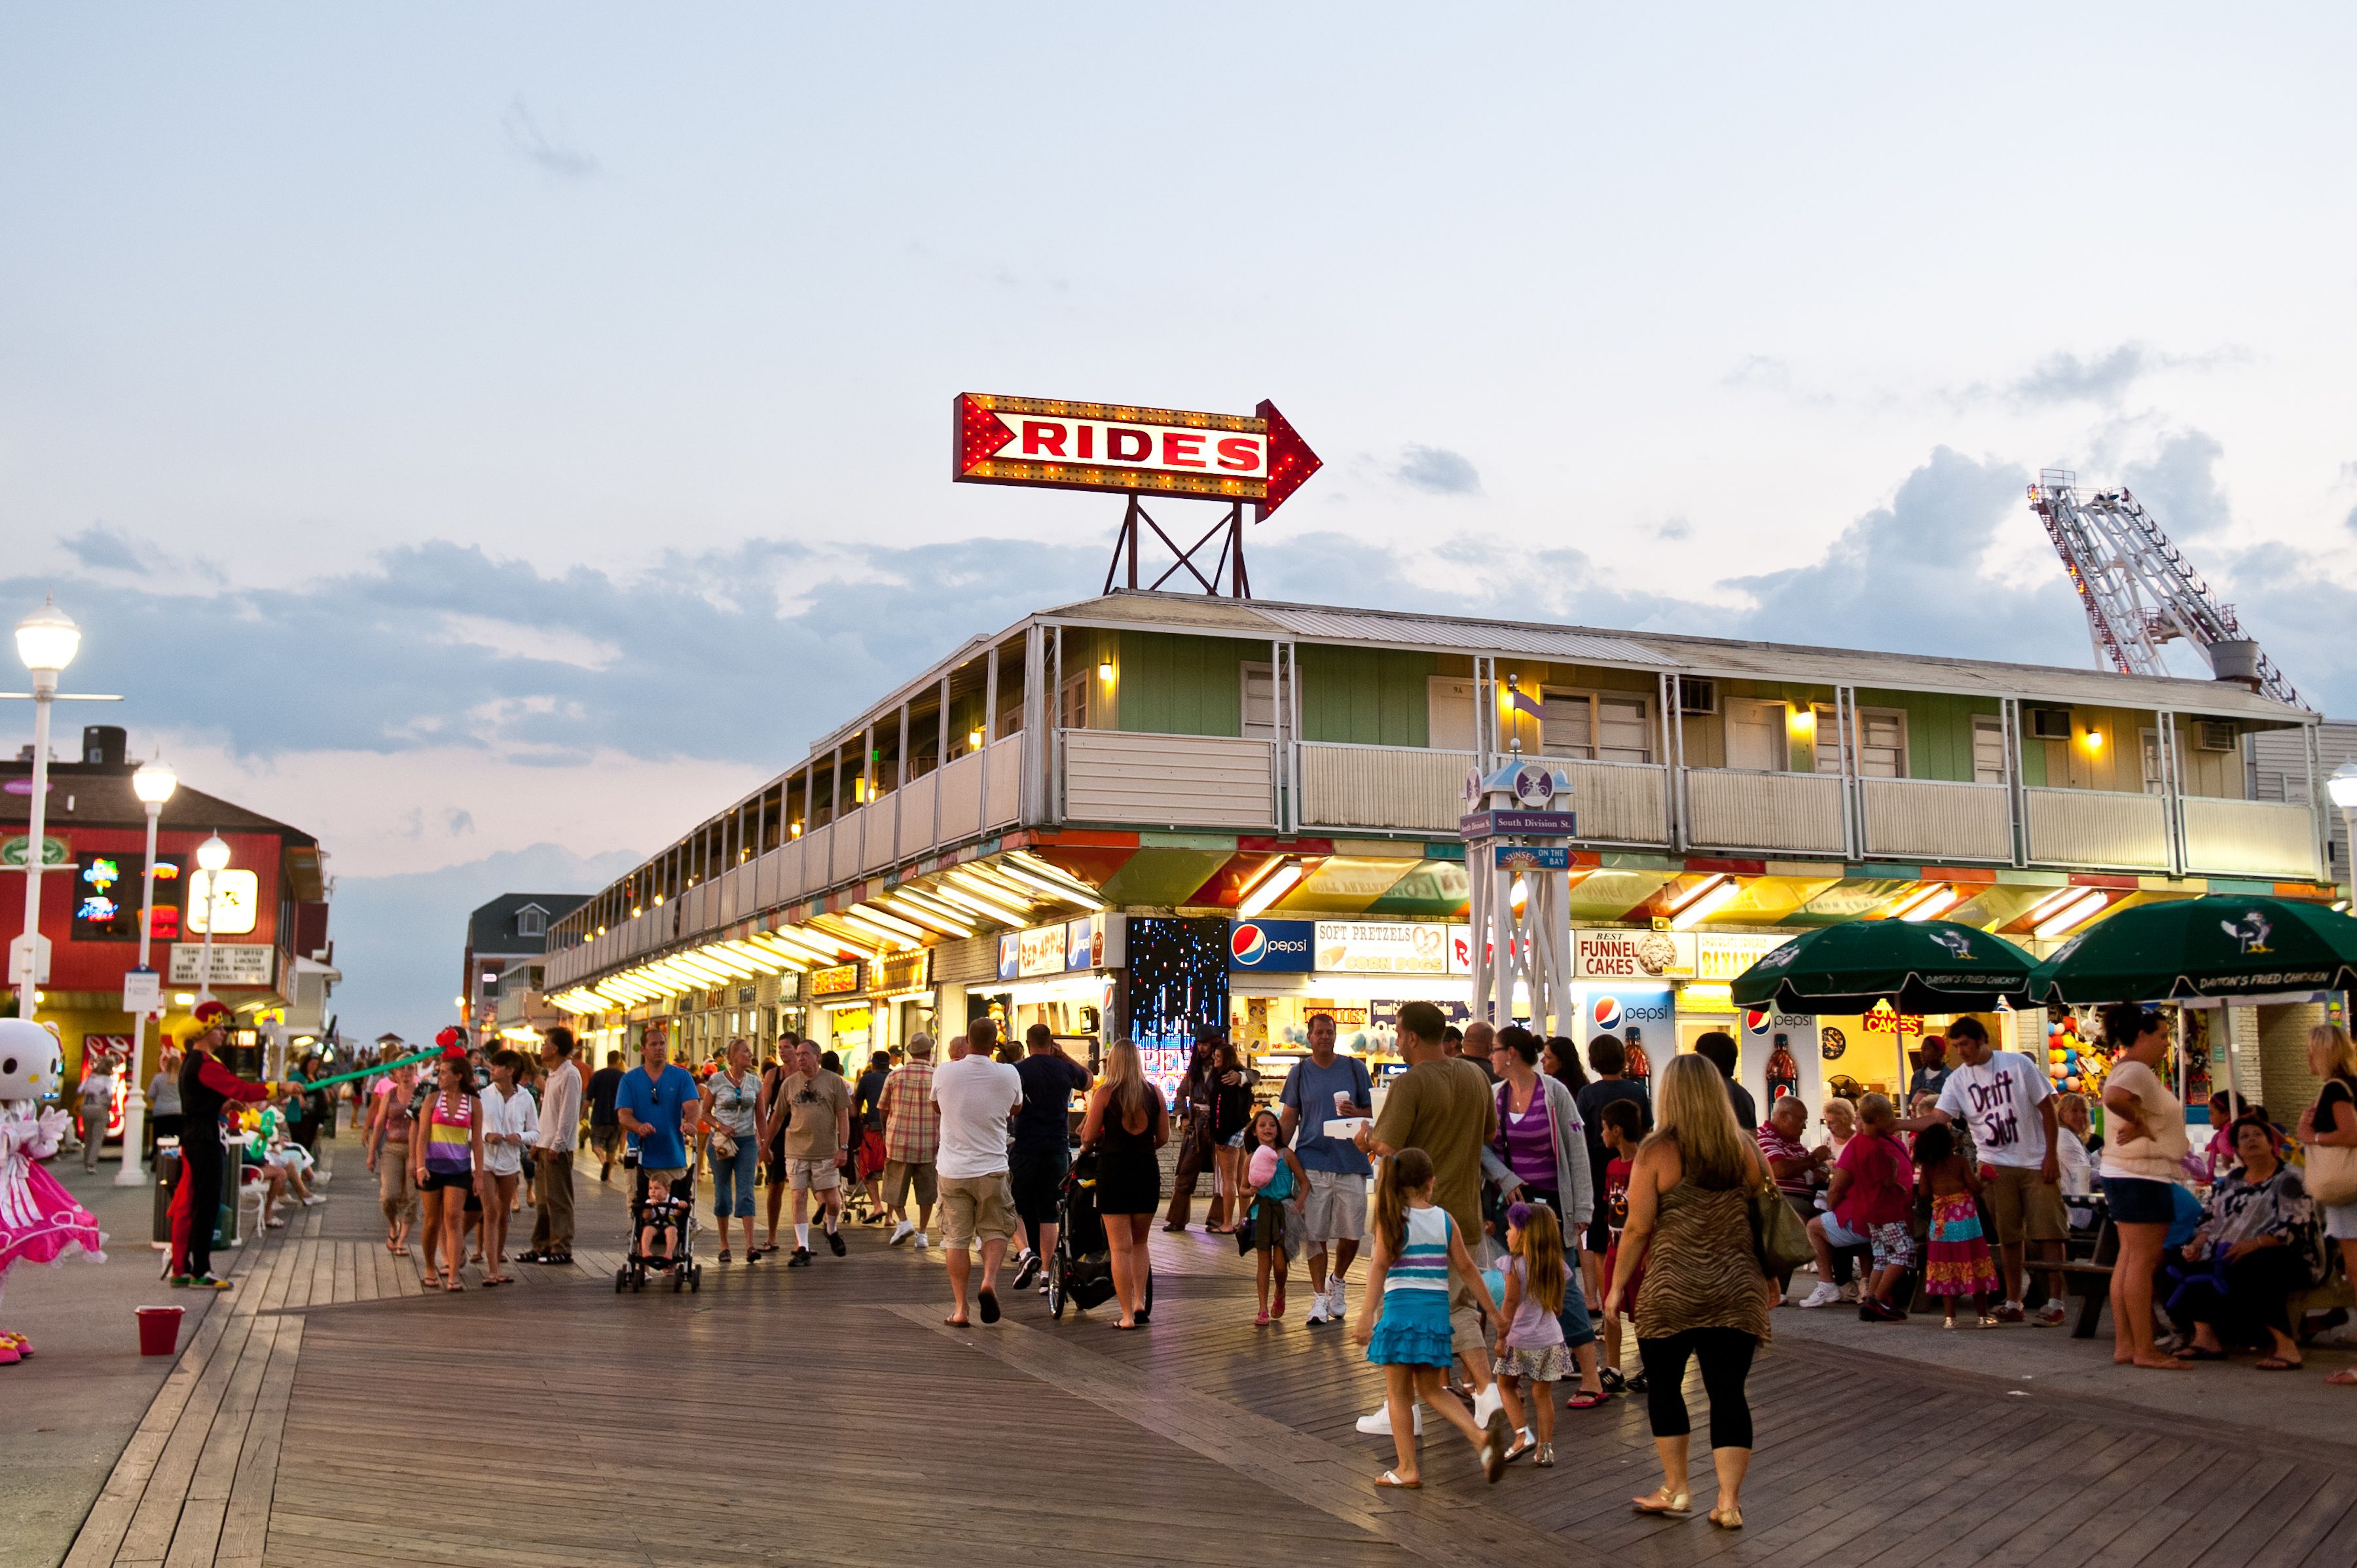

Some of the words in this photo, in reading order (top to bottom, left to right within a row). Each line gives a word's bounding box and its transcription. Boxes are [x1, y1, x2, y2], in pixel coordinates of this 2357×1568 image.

[1022, 420, 1260, 471] RIDES
[1497, 818, 1522, 827] South
[1524, 819, 1558, 828] Division
[1560, 820, 1571, 828] St.
[1506, 851, 1536, 863] SUNSET
[1319, 925, 1347, 940] SOFT
[1352, 926, 1410, 941] PRETZELS
[1021, 943, 1037, 969] RED
[1039, 930, 1065, 959] APPLE
[1268, 939, 1307, 954] pepsi
[1580, 941, 1640, 957] FUNNEL
[1345, 956, 1392, 970] CORN
[1395, 957, 1443, 971] DOGS
[1586, 958, 1634, 975] CAKES
[1962, 975, 1986, 984] FRIED
[2250, 973, 2282, 985] FRIED
[2282, 972, 2330, 983] CHICKEN
[1625, 1005, 1668, 1023] pepsi
[1774, 1014, 1812, 1029] pepsi
[1867, 1017, 1919, 1034] CAKES
[1968, 1070, 2013, 1112] Drift
[1984, 1108, 2019, 1146] Slut
